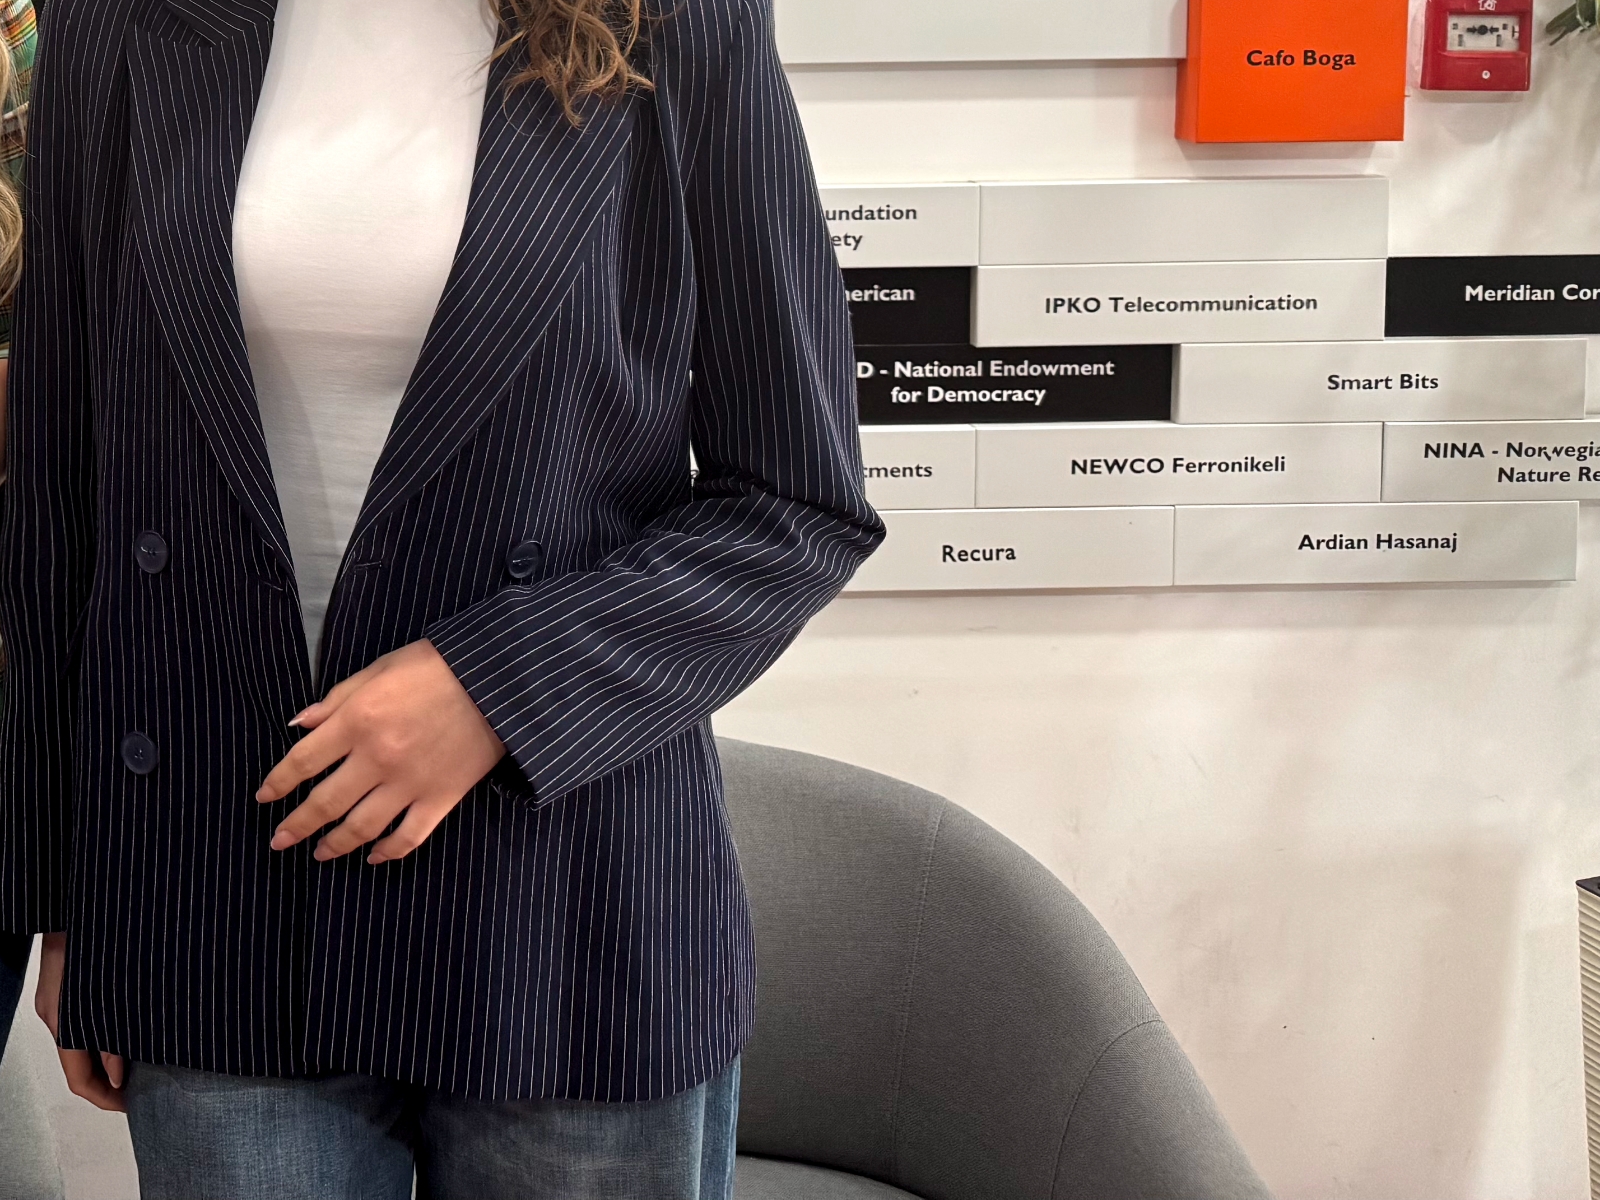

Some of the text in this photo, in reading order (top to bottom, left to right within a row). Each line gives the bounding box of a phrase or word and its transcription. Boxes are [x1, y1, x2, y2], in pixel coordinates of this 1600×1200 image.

[1246, 49, 1357, 71] Cafo Boga
[824, 204, 918, 221] undation
[845, 284, 916, 302] erican
[1465, 284, 1556, 302] Meridian
[1045, 294, 1318, 314] IPKO Telecommunication
[894, 360, 983, 378] National
[989, 359, 1115, 377] Endowment
[1327, 373, 1439, 391] Smart Bits
[890, 385, 1047, 406] for Democracy
[1423, 442, 1485, 459] NINA
[1071, 455, 1286, 475] NEWCO Ferronikeli
[1497, 466, 1571, 483] Nature
[1297, 532, 1458, 554] Ardian Hasanaj
[942, 544, 1017, 563] Recura
